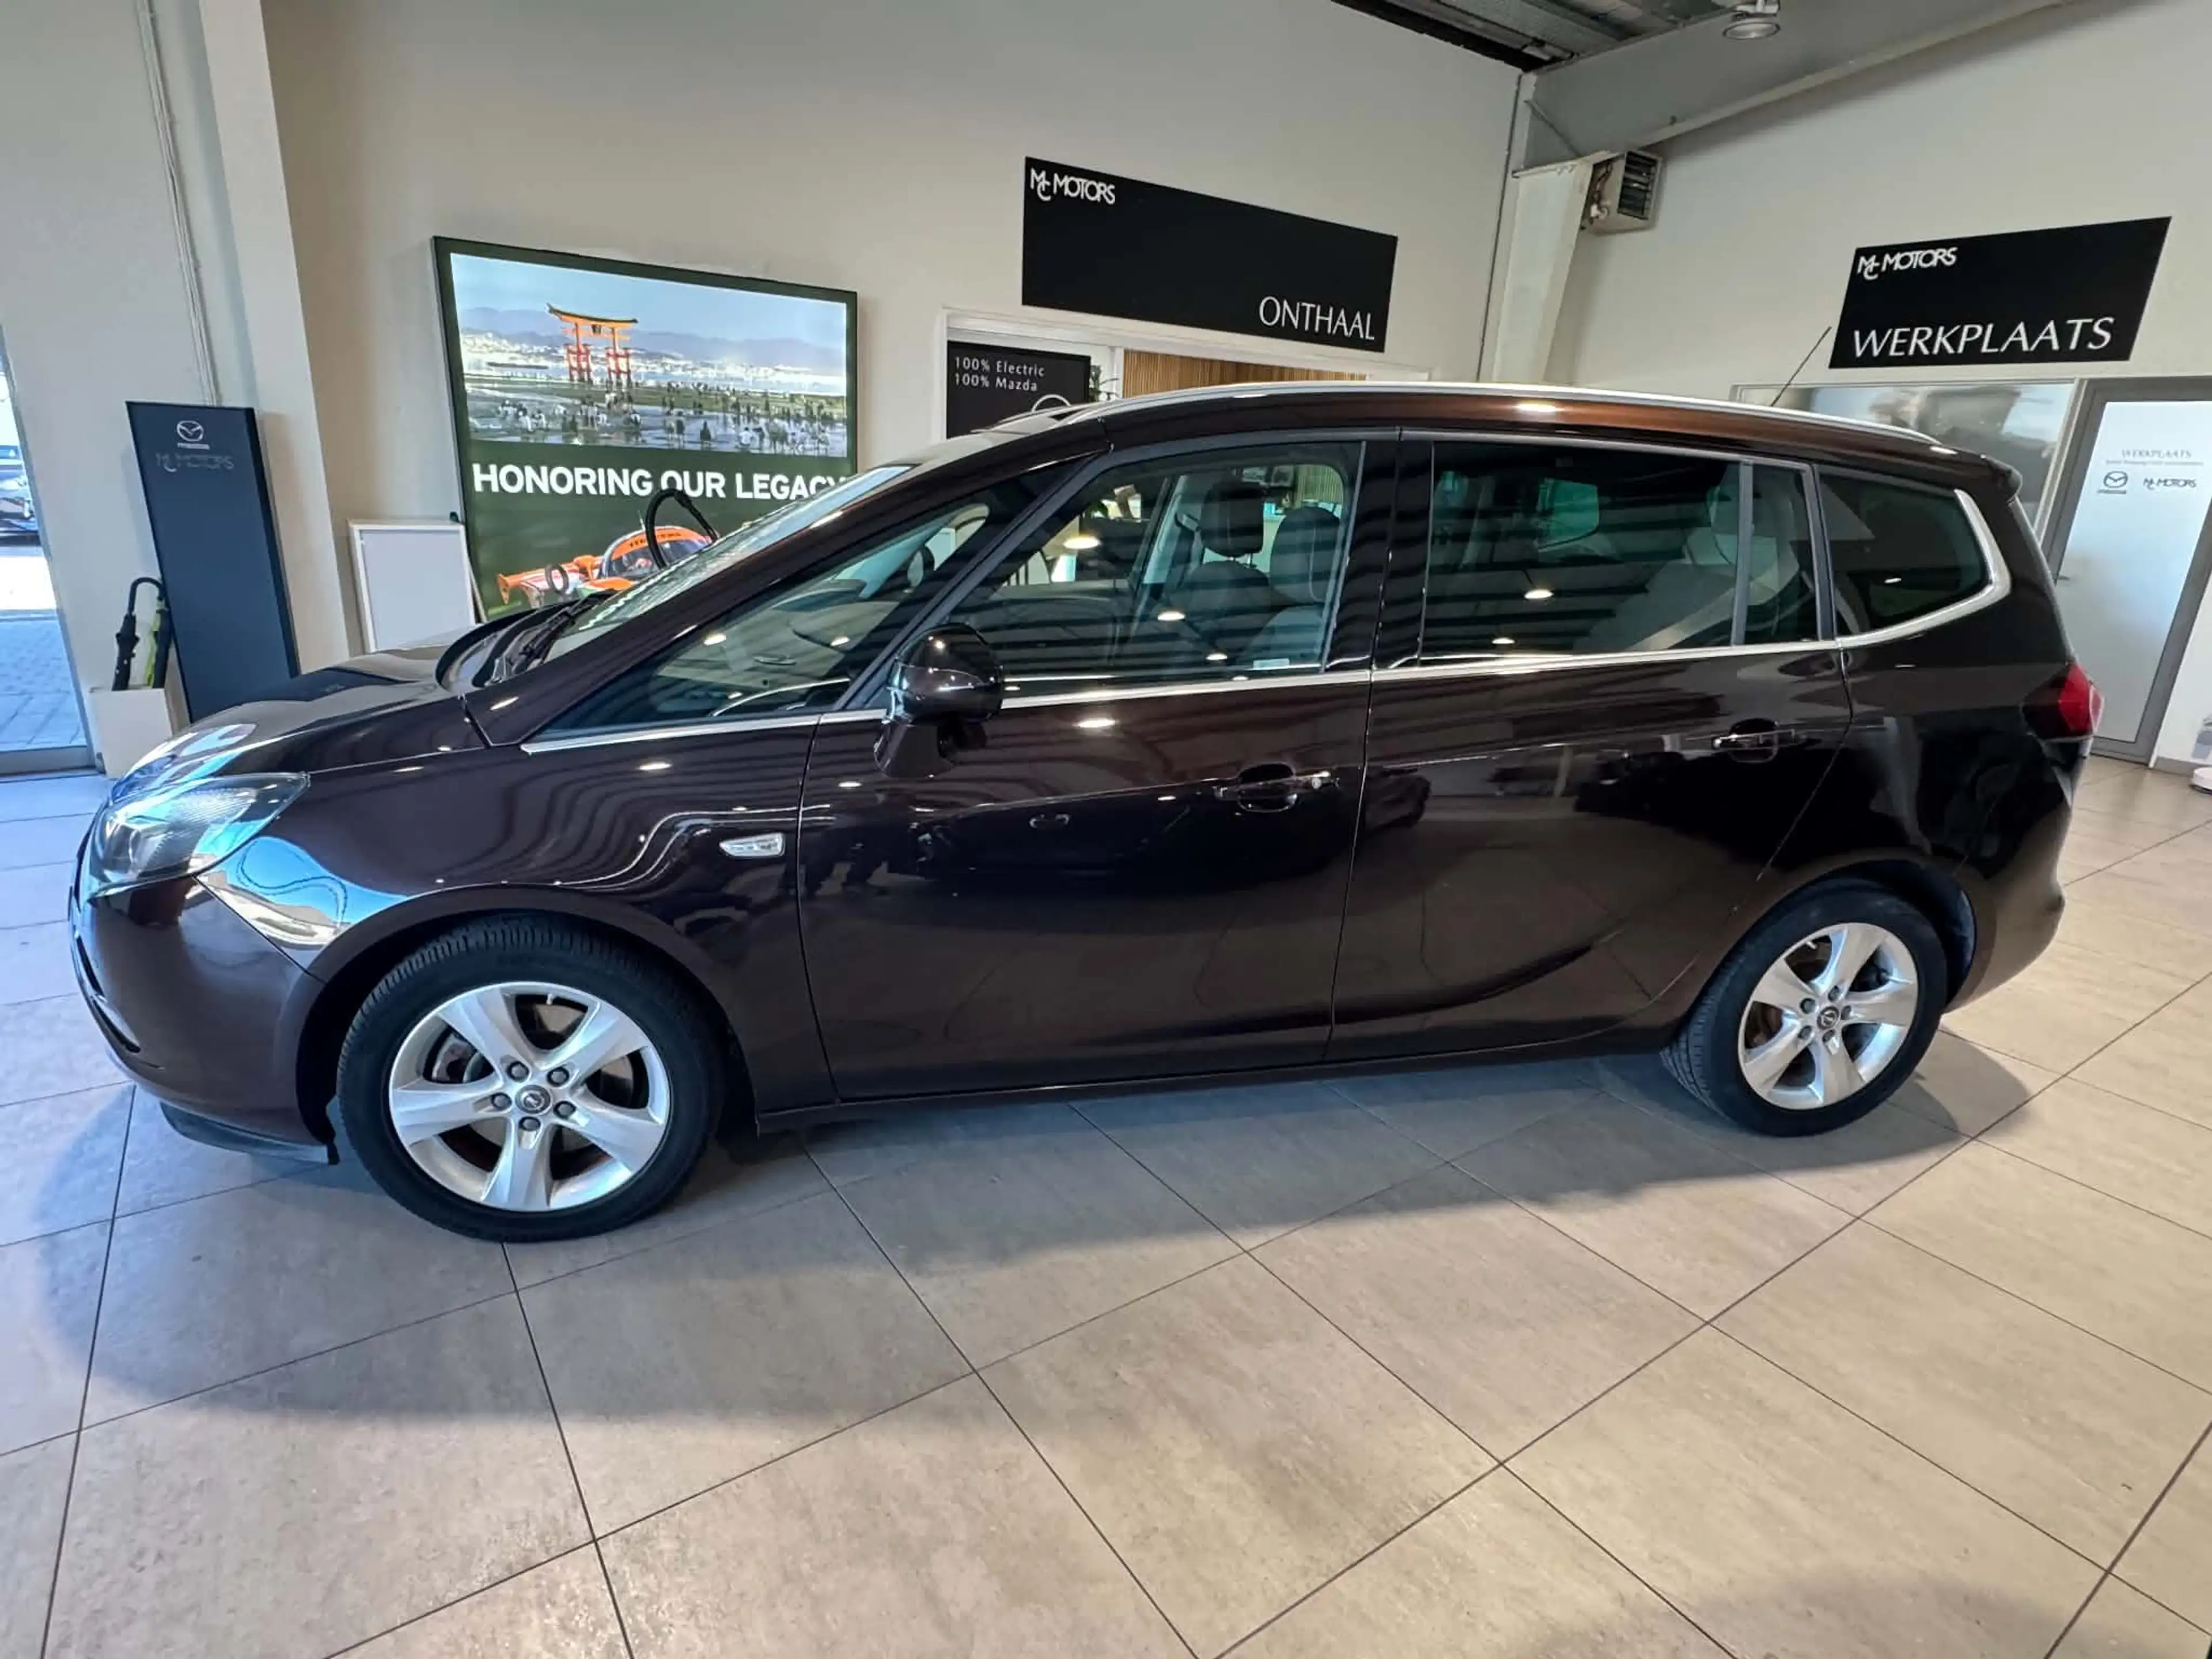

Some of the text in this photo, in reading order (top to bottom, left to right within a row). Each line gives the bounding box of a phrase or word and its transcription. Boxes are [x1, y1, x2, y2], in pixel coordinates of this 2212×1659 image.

[1053, 172, 1116, 205] MOTORS
[1881, 246, 1958, 272] MOTORS
[1259, 296, 1375, 340] ONTHAAL
[1853, 316, 2115, 358] WERKPLAATS
[954, 373, 1038, 392] 100% Mazda
[955, 357, 1046, 377] 100% Electric
[472, 463, 653, 497] HONORING
[661, 469, 726, 498] OUR
